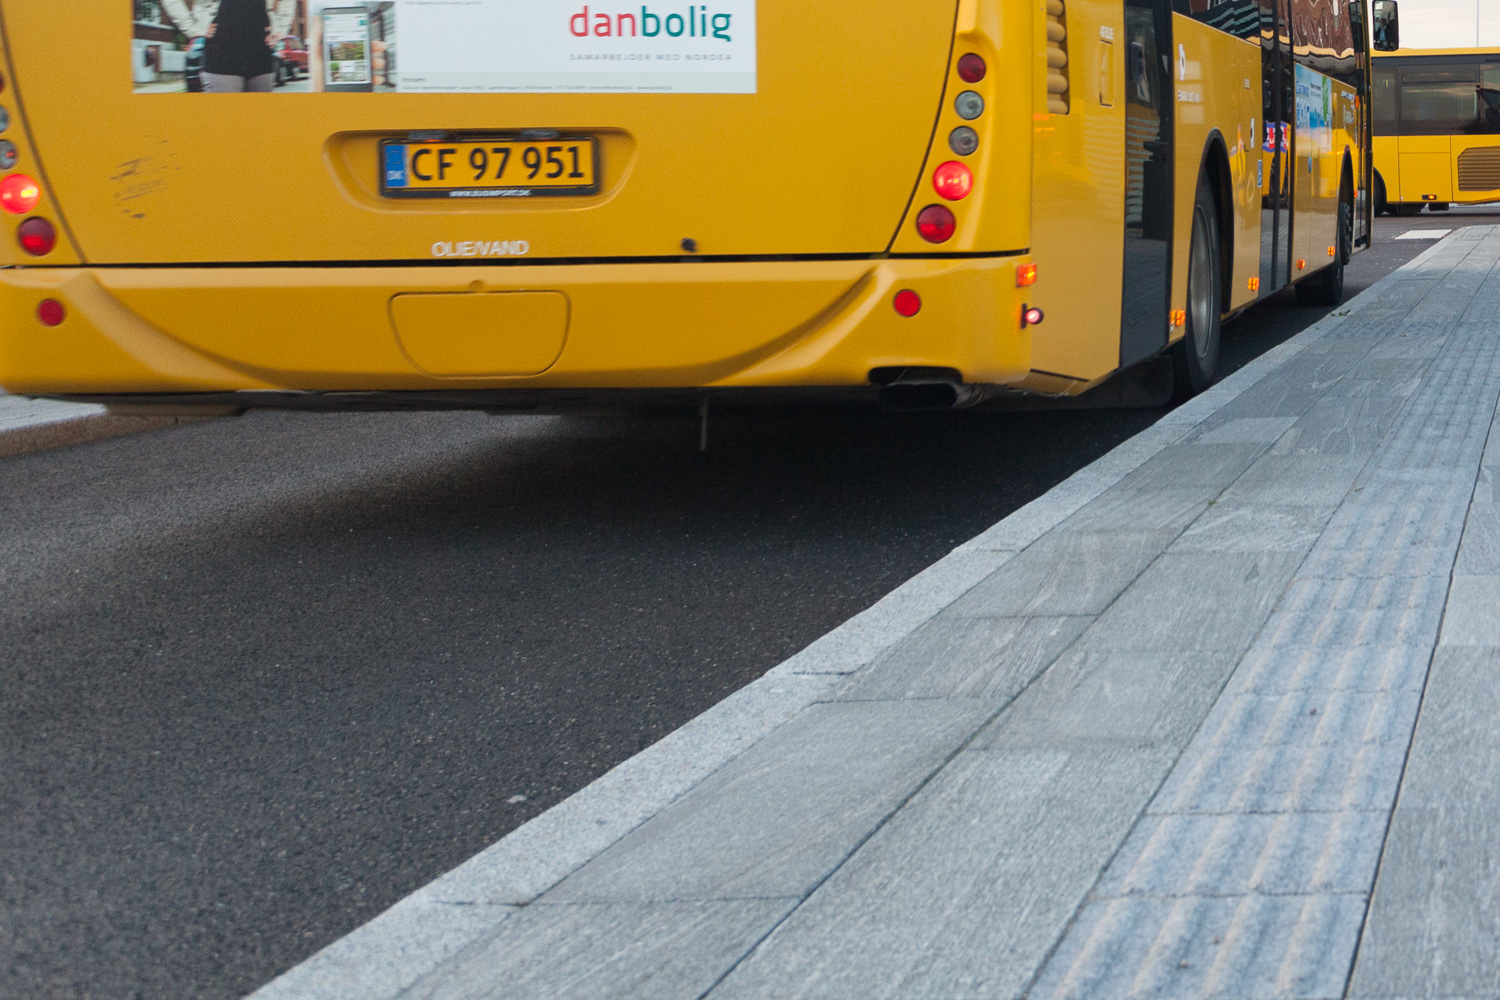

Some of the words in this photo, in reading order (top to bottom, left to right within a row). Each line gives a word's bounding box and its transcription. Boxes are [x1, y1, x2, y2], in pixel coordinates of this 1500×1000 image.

[570, 5, 732, 42] danbolig
[569, 53, 651, 61] SAMARBEJDER
[655, 53, 681, 61] MED
[685, 53, 732, 61] NORDEA
[387, 170, 404, 180] DK
[412, 148, 456, 181] CF
[469, 147, 511, 180] 97
[522, 146, 584, 180] 951
[431, 240, 530, 257] OLIE/VAND
